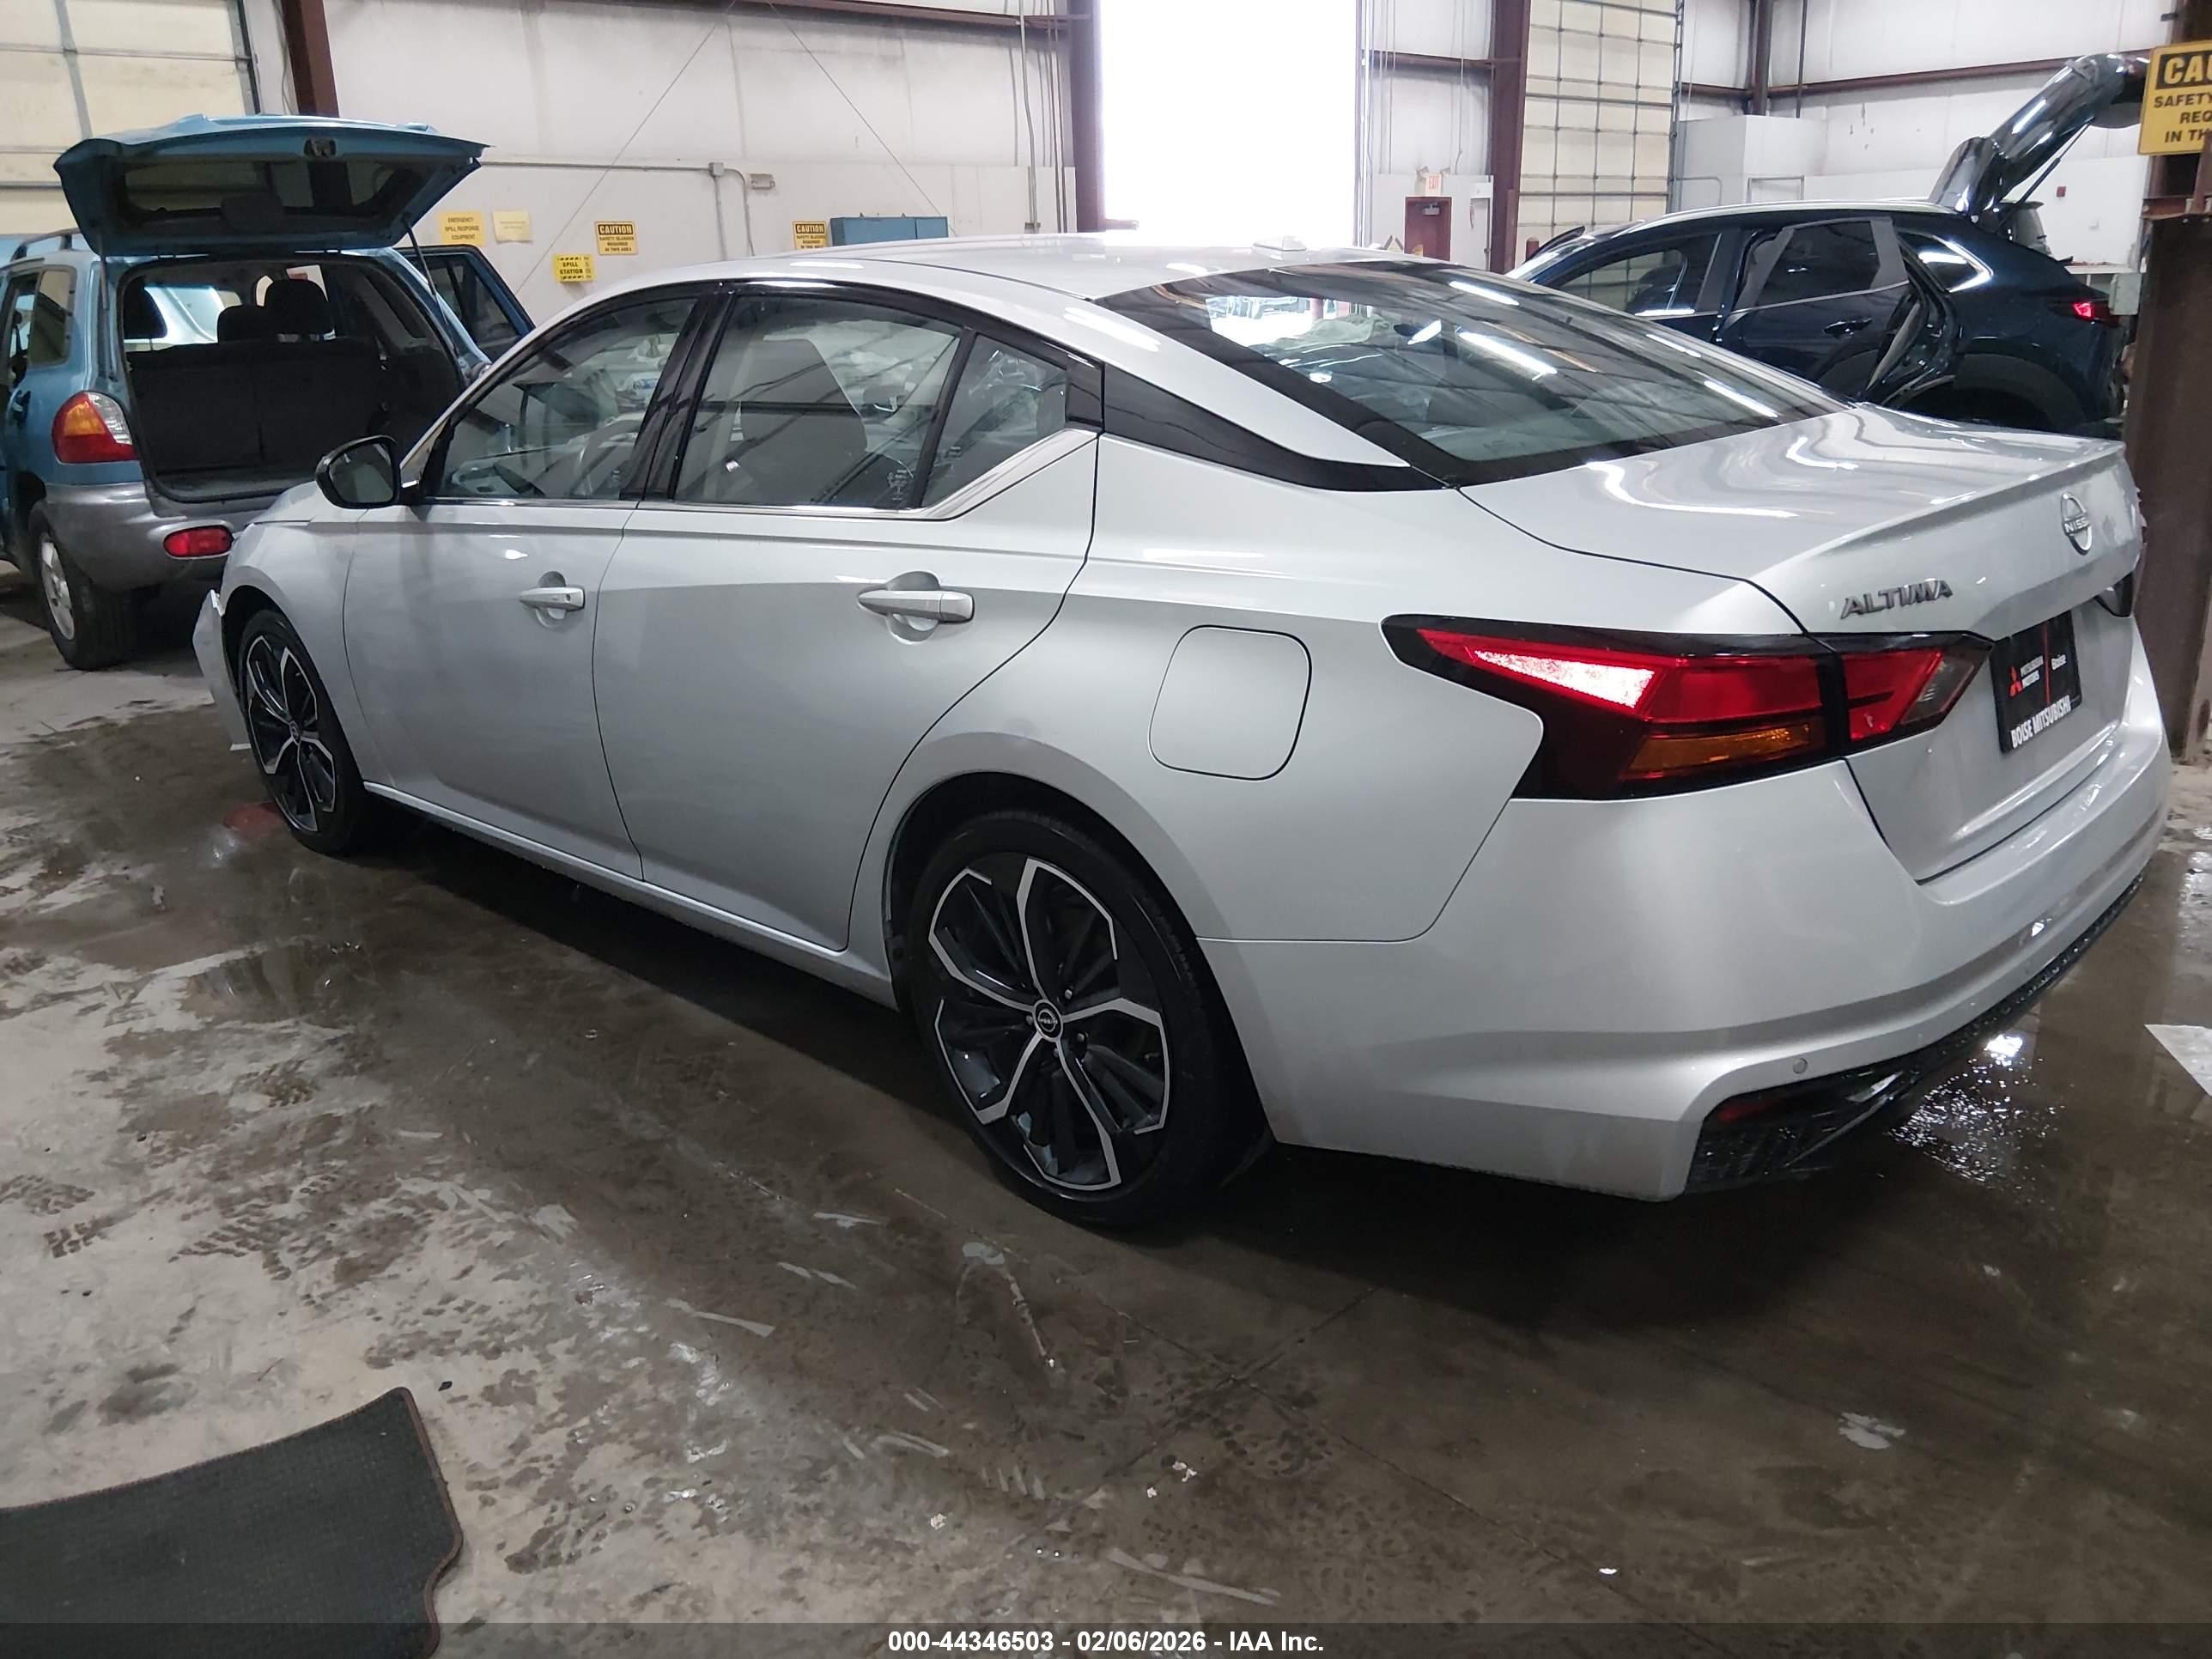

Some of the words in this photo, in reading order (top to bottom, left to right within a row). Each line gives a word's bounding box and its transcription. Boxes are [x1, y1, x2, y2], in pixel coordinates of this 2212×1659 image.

[2165, 130, 2182, 143] IN
[599, 225, 633, 234] CAUTION
[1840, 578, 1954, 619] ALTIMA
[2010, 719, 2033, 749] BOISE
[2032, 695, 2072, 734] MITSUBISHI
